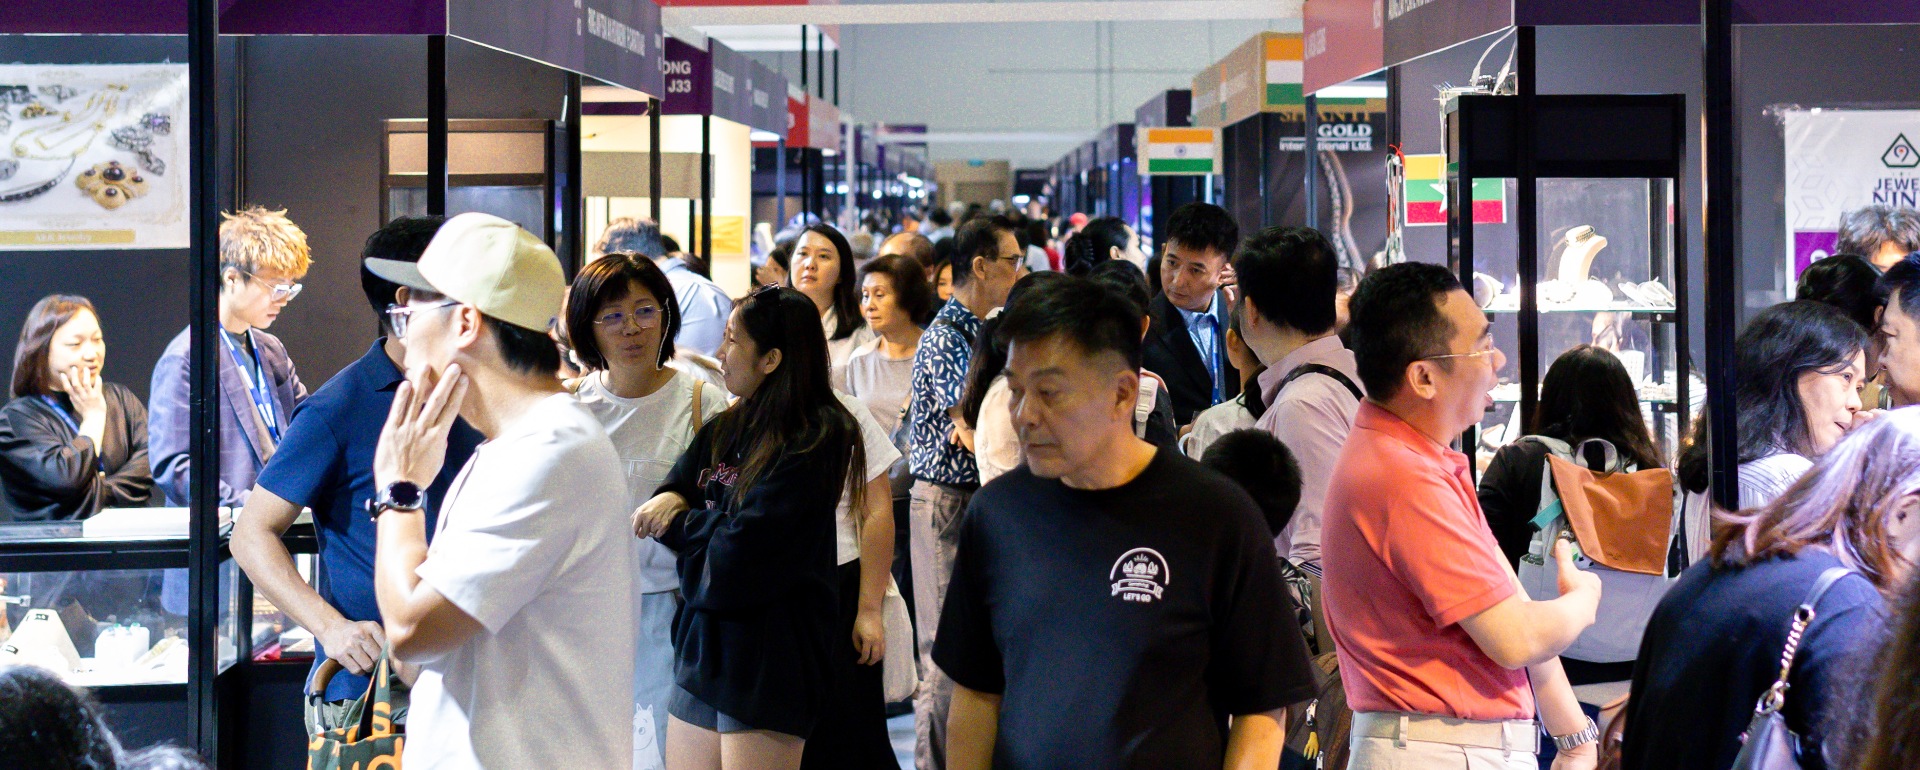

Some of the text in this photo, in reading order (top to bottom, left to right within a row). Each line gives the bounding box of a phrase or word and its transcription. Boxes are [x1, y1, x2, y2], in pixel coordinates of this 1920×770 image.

[667, 79, 692, 94] J33
[1318, 123, 1372, 137] GOLD
[1351, 141, 1372, 151] Ltd.
[1875, 178, 1920, 190] JEWE
[1123, 592, 1151, 602] LET'S GO
